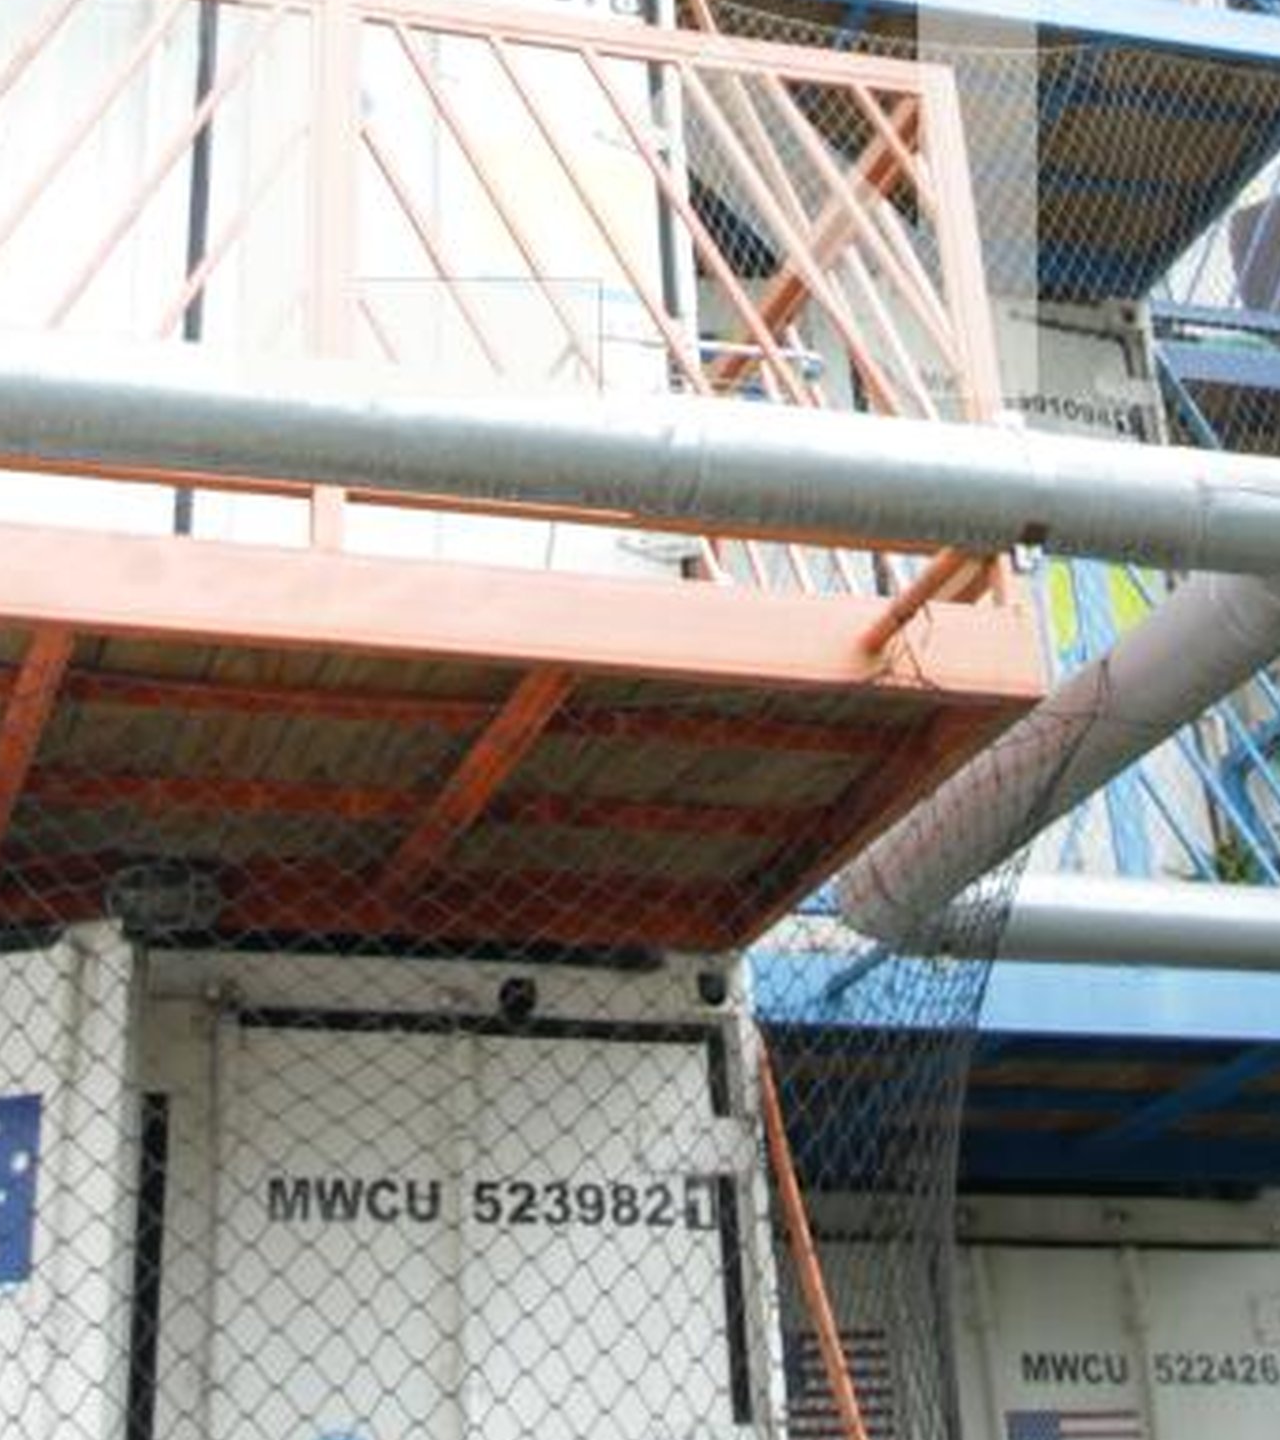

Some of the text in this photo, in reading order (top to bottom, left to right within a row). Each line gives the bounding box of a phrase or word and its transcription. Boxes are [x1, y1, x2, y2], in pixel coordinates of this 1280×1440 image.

[268, 1178, 441, 1222] MWCU
[473, 1181, 675, 1227] 523982
[1022, 1352, 1128, 1385] MWCU
[1154, 1352, 1280, 1387] 522426
